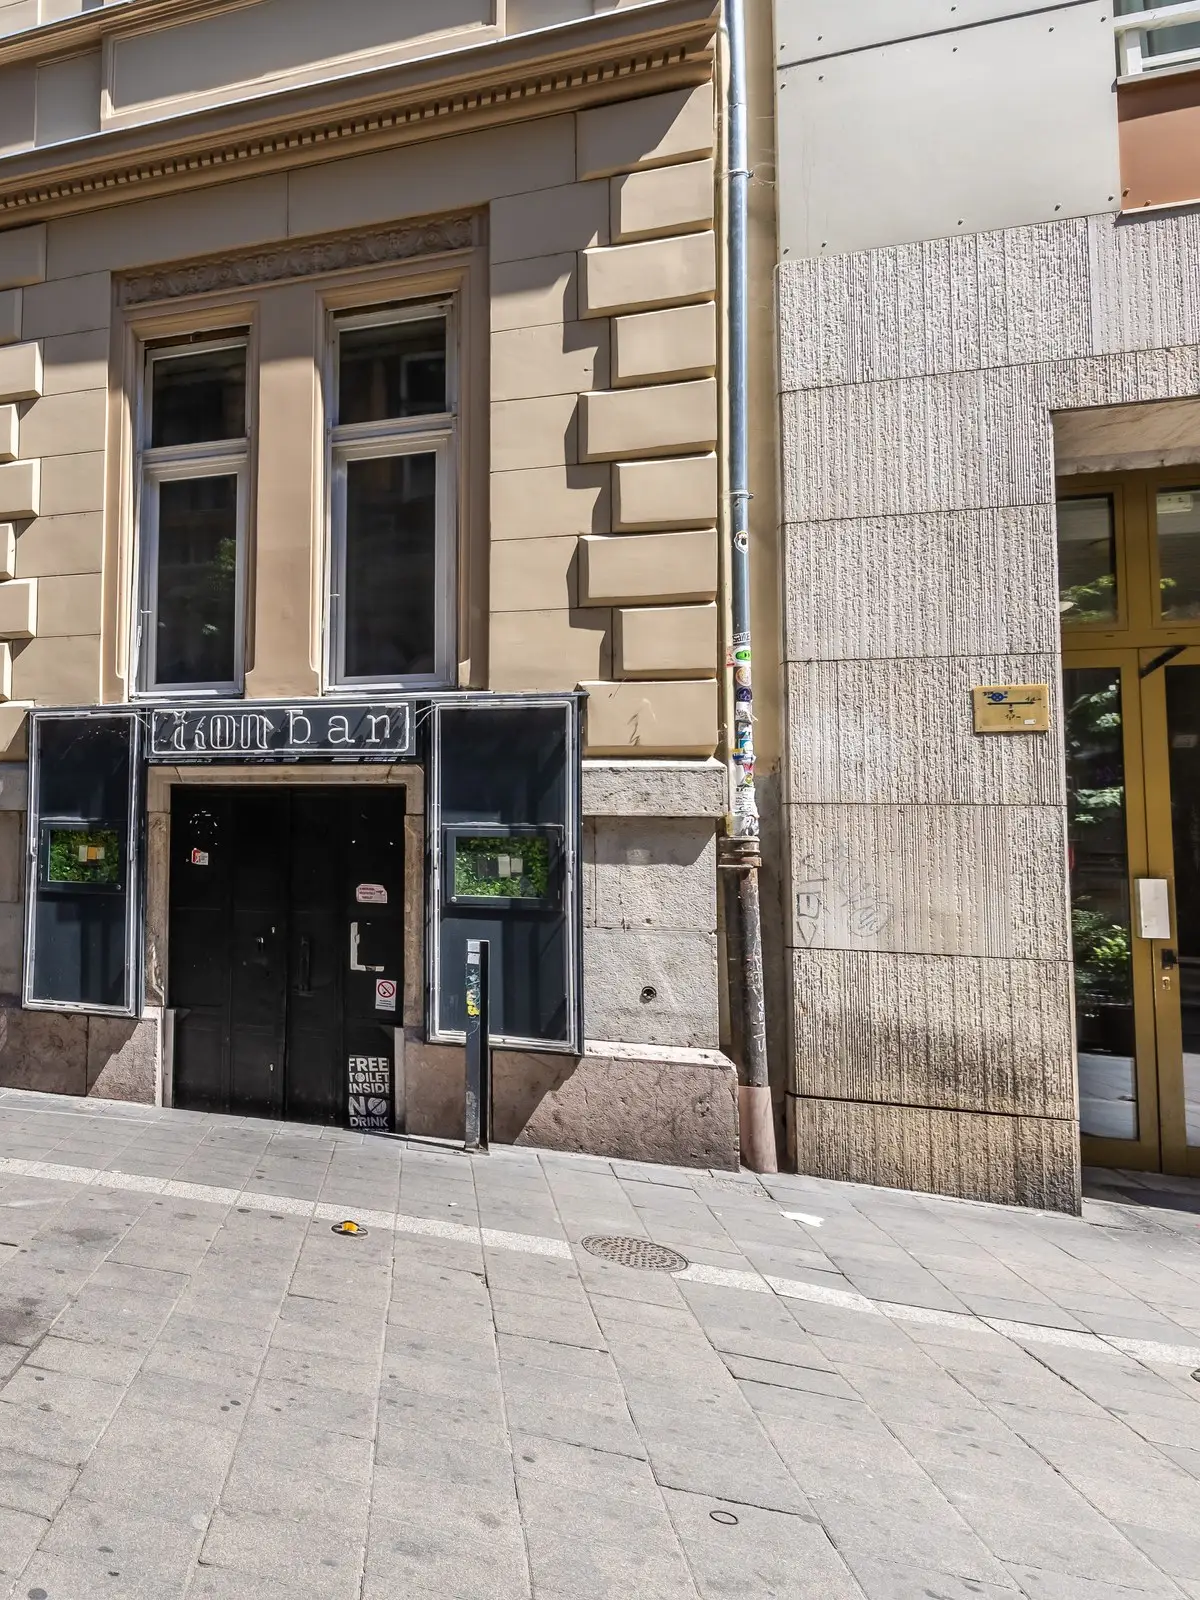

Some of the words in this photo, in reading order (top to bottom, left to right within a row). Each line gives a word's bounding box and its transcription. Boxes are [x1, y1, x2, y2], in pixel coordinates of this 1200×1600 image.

[348, 1057, 388, 1072] FREE
[349, 1072, 390, 1082] TOILET
[349, 1116, 388, 1127] DRINK
